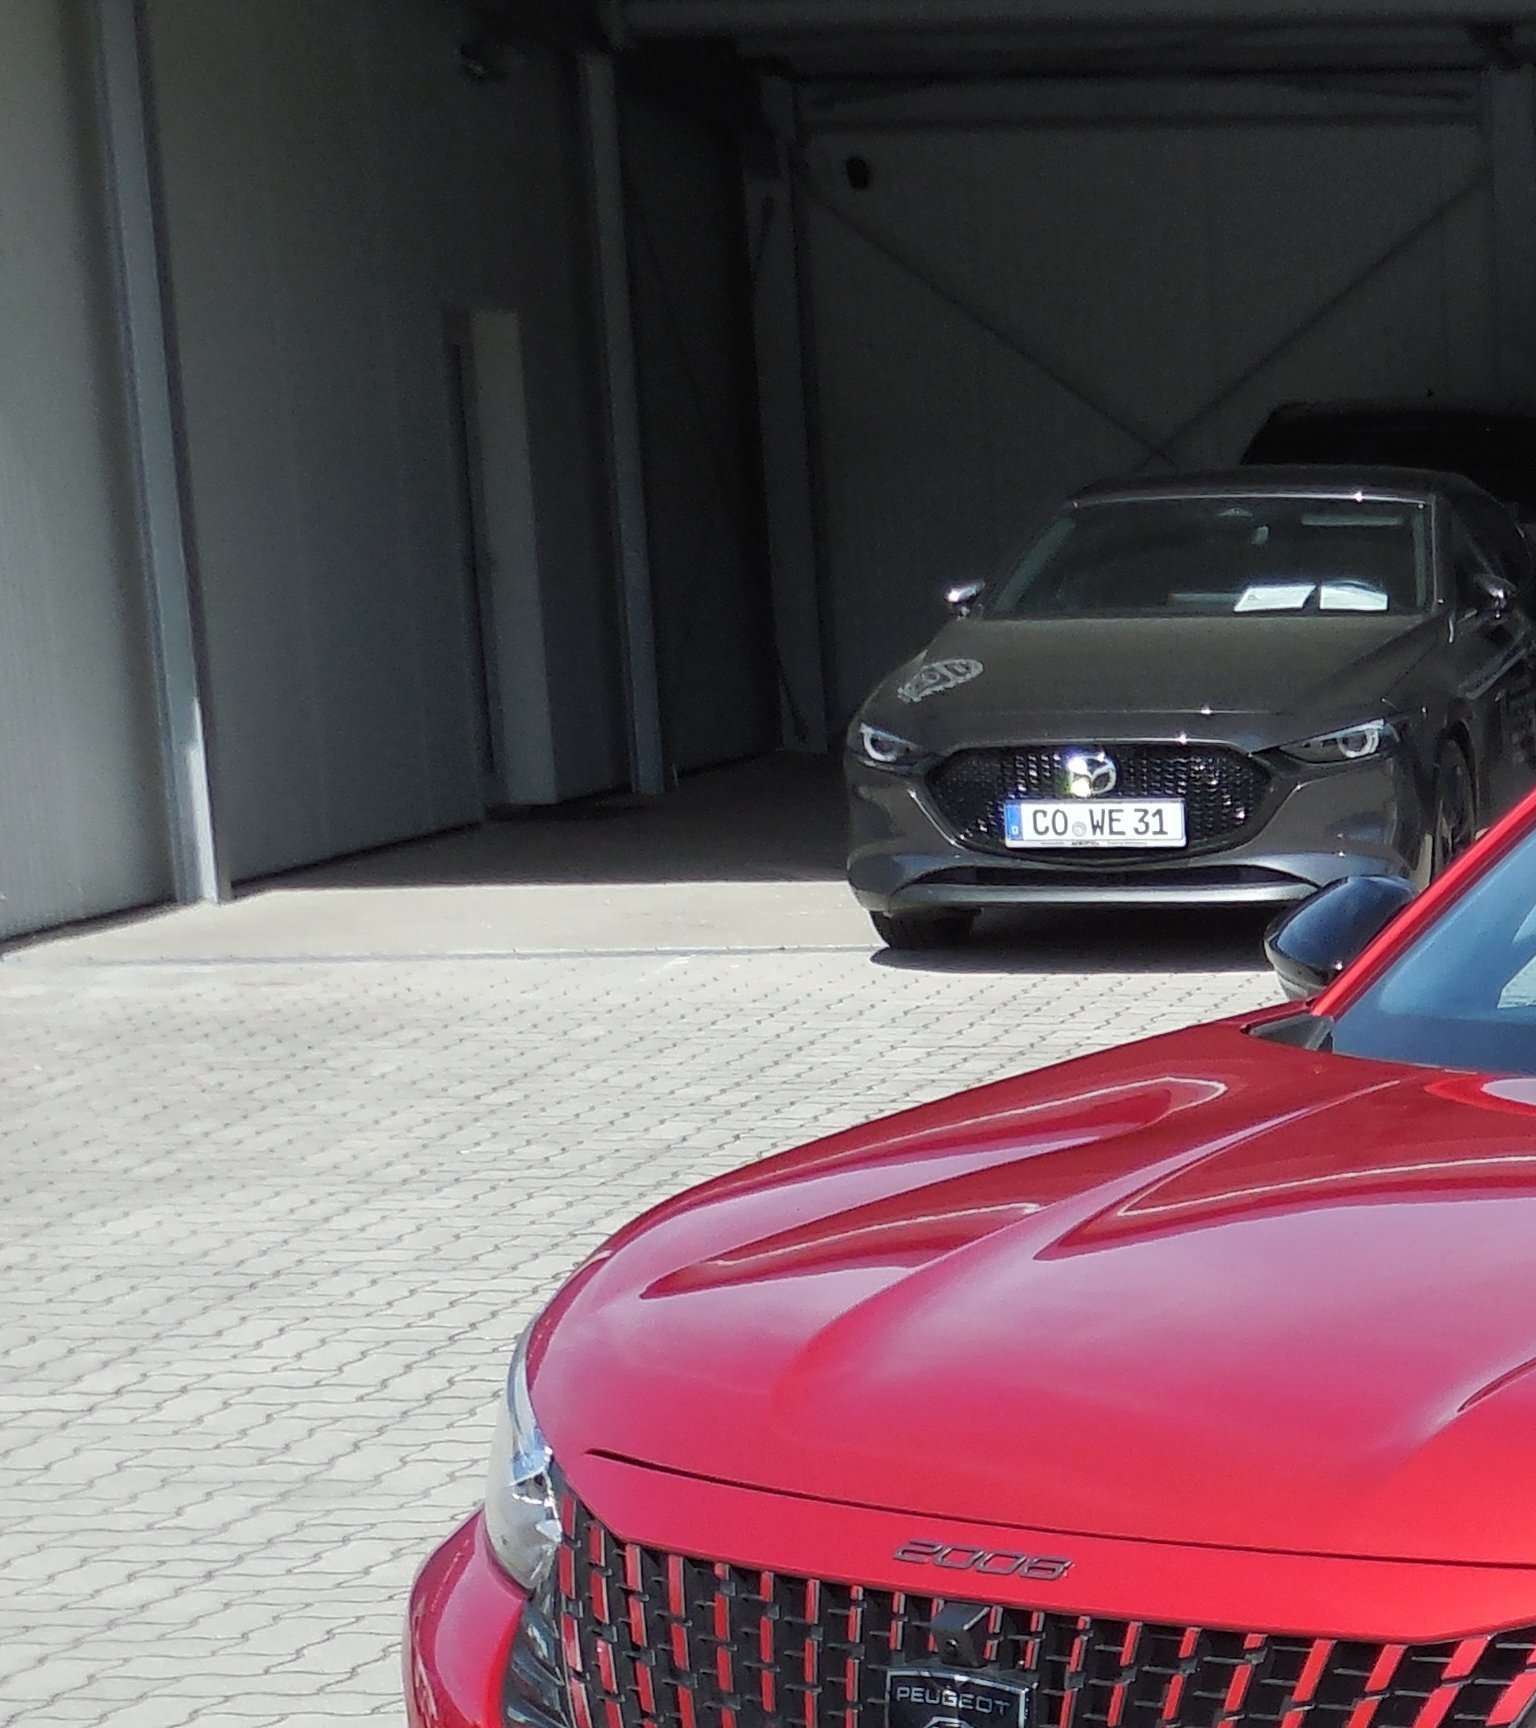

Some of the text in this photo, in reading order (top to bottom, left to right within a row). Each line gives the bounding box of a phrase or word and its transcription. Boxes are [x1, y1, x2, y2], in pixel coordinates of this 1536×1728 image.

[1032, 808, 1069, 836] CO
[1088, 808, 1127, 836] WE
[1133, 808, 1169, 836] 31
[894, 1539, 1074, 1580] 2008
[896, 1685, 1011, 1716] PEUGEOT
